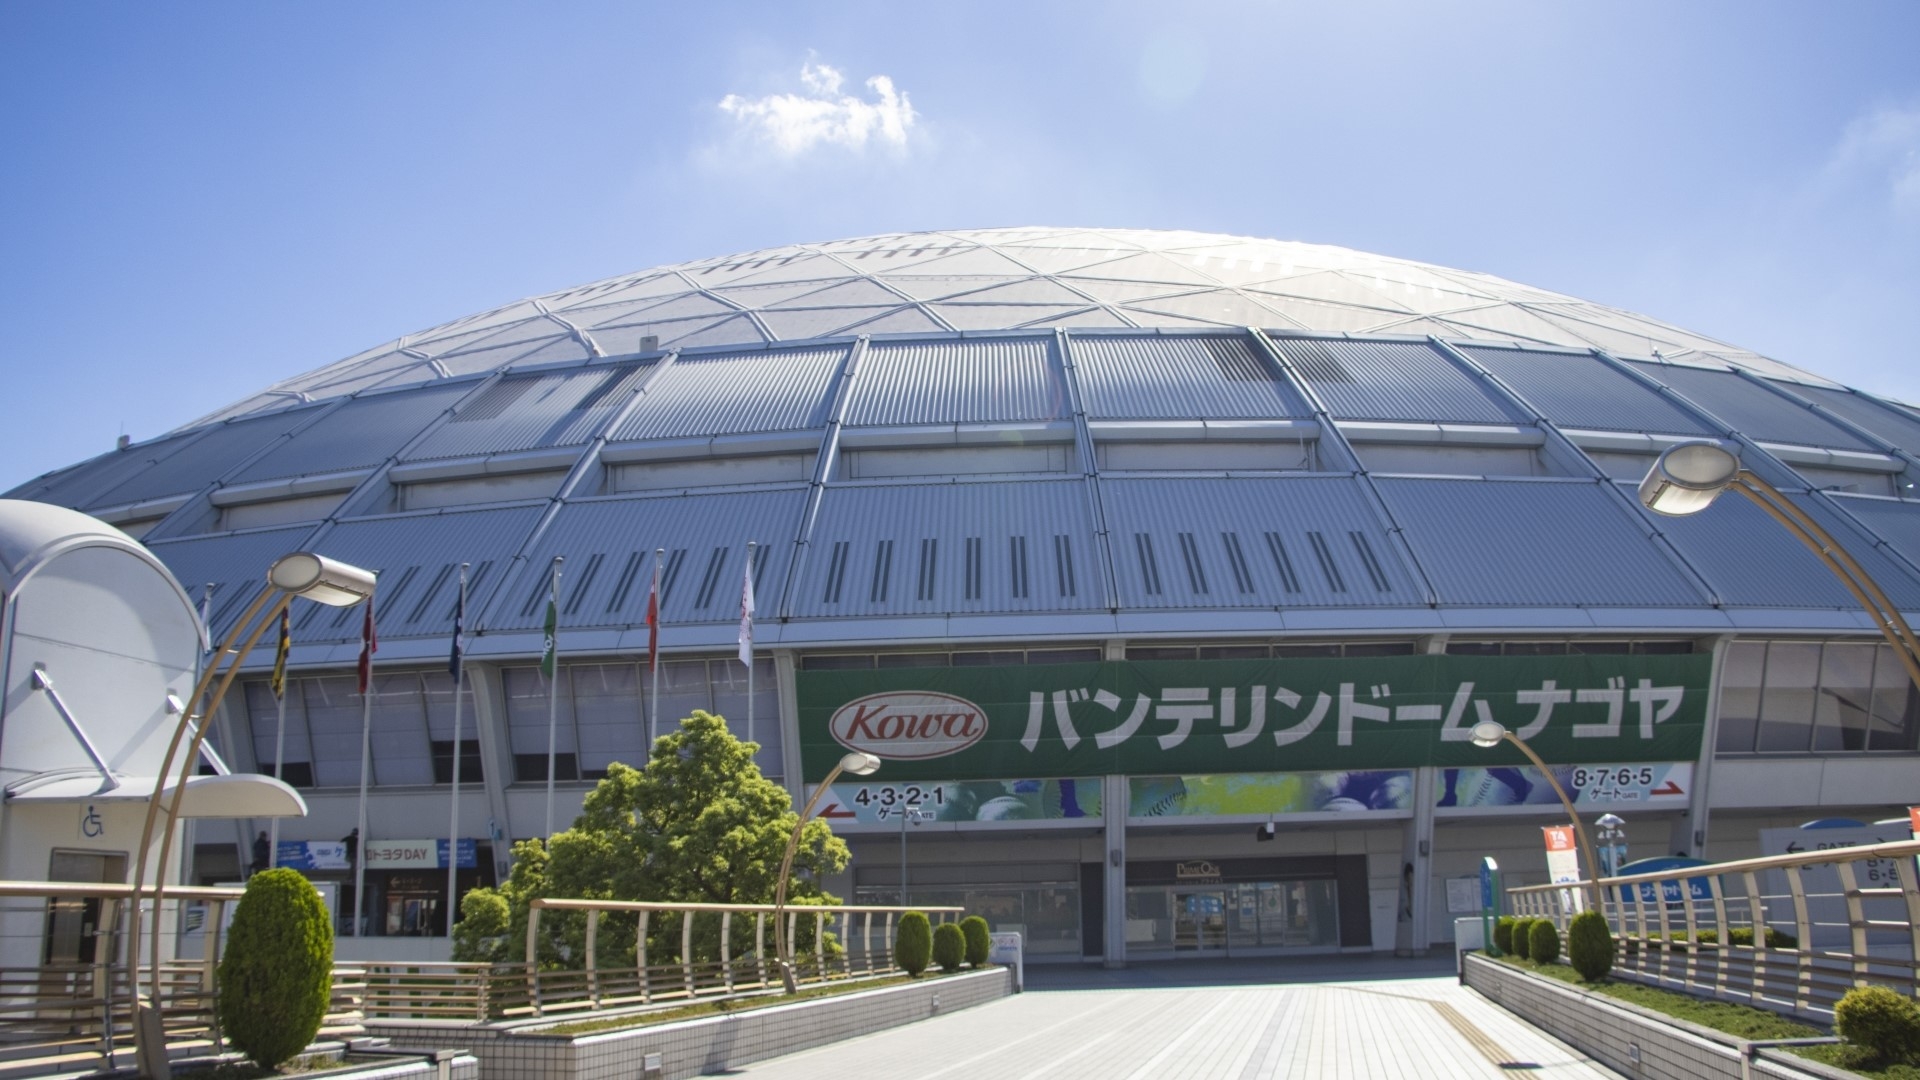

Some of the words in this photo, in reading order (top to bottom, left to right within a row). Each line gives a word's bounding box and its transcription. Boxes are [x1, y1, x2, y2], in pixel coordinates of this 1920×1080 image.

[846, 704, 979, 740] Kowa
[1020, 682, 1490, 753] バンテリンドーム
[1514, 677, 1685, 740] ナゴヤ
[1590, 788, 1621, 799] ゲート
